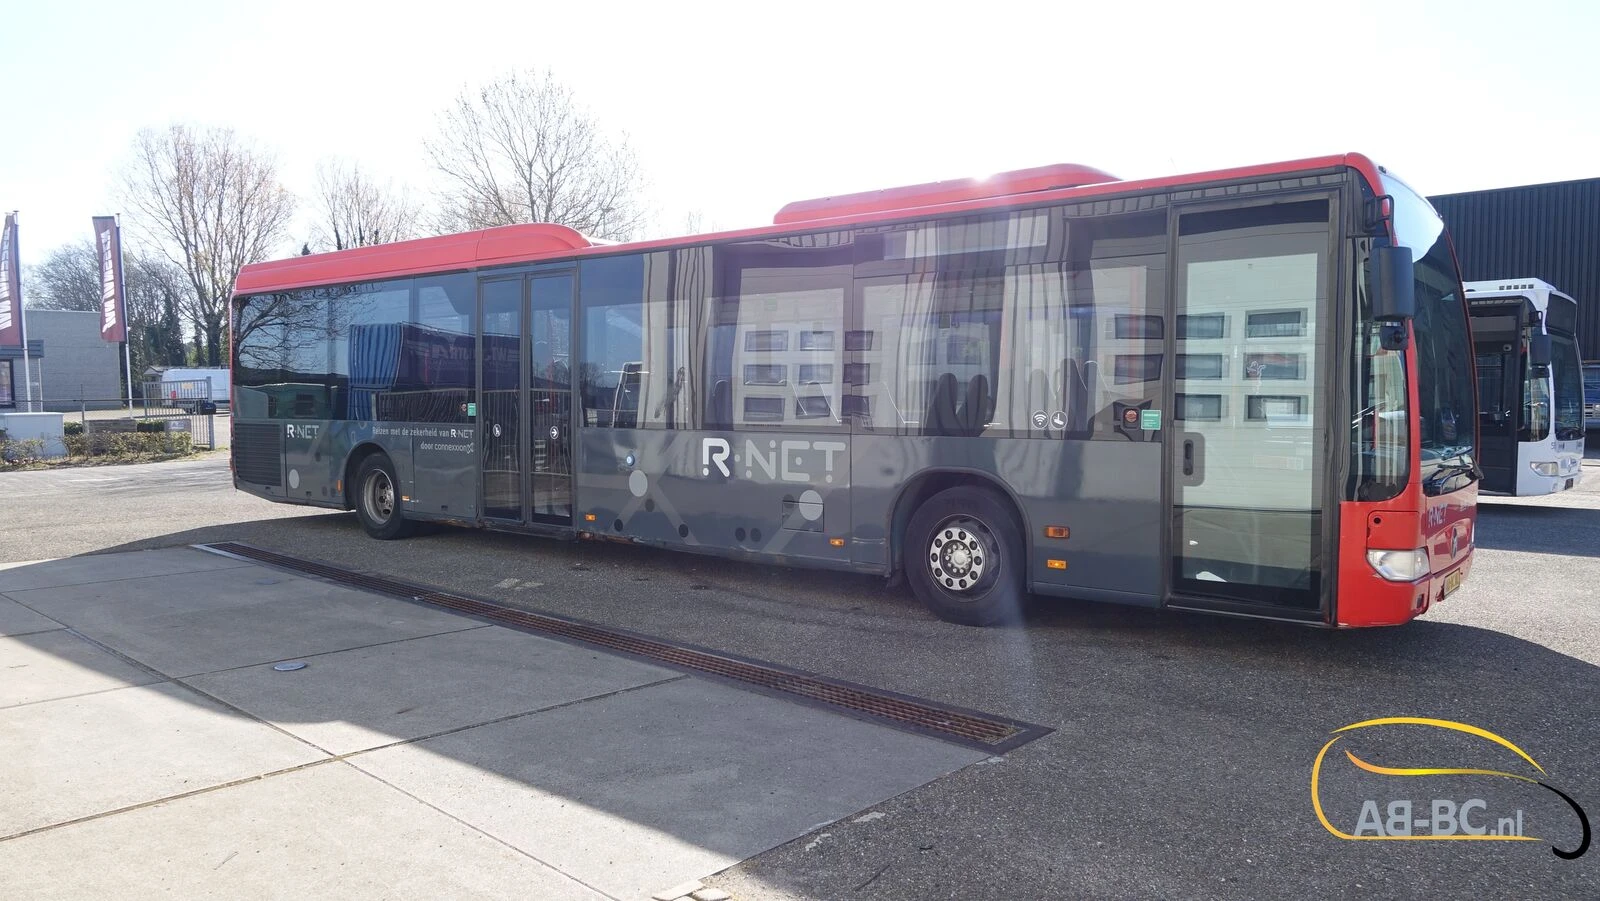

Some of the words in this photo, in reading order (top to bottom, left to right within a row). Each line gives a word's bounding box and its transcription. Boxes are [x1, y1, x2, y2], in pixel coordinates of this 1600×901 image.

[372, 426, 389, 435] Reizen
[390, 427, 400, 436] met
[402, 427, 409, 436] de
[410, 427, 438, 437] zekerheid
[439, 429, 449, 437] van
[420, 441, 434, 450] door
